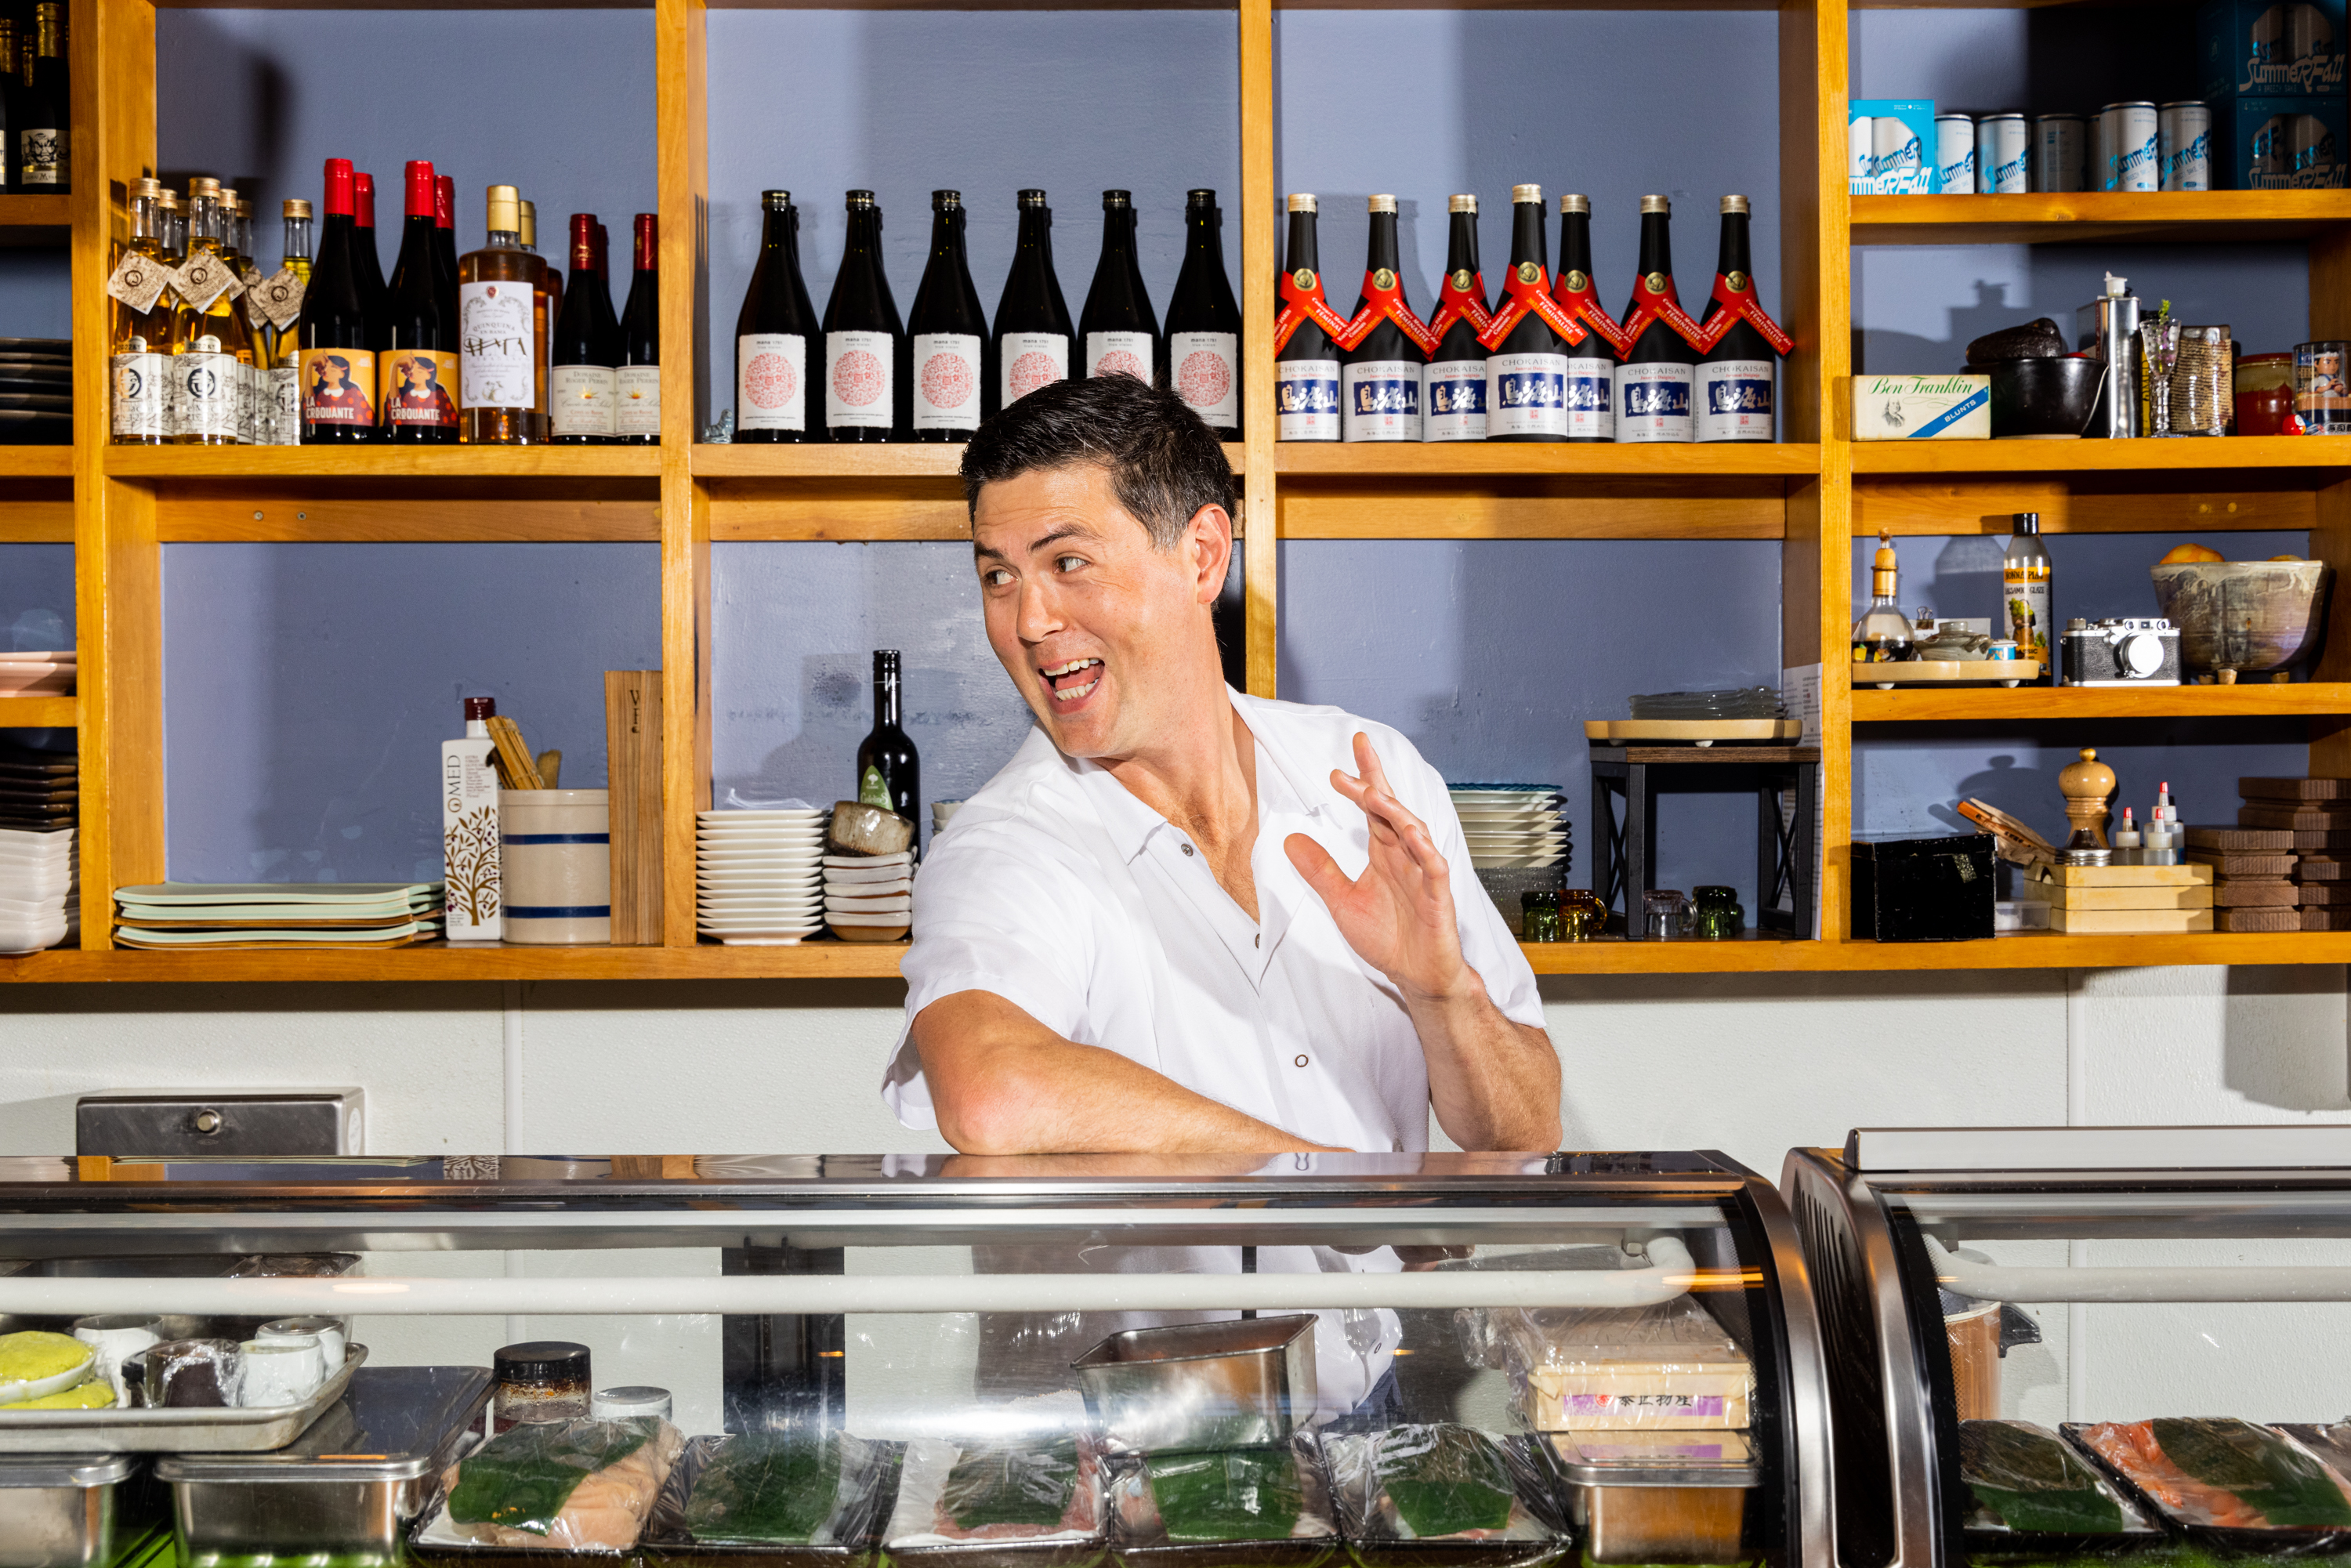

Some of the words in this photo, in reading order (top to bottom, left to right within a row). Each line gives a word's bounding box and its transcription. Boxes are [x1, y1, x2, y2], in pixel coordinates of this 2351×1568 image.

[1278, 308, 1291, 324] PARIS
[1302, 304, 1317, 317] 2023
[1314, 314, 1333, 331] GOLD
[1310, 296, 1335, 317] Concours
[1332, 314, 1348, 328] Mond
[1391, 297, 1414, 320] Concours
[1411, 317, 1432, 338] Mondial
[1429, 335, 1439, 345] des
[1434, 309, 1447, 324] PARIS
[1458, 305, 1472, 319] 2023
[1467, 296, 1489, 320] Concours
[1481, 328, 1493, 340] Kura
[1490, 314, 1504, 330] Master
[1501, 301, 1516, 317] PARIS
[1525, 296, 1540, 311] 2023
[1538, 308, 1556, 326] GOLD
[1552, 322, 1575, 345] MEDAL
[1534, 288, 1557, 311] Concours
[1556, 309, 1576, 329] Mondial
[1574, 327, 1584, 337] des
[1583, 298, 1606, 319] Concours
[1603, 317, 1625, 336] Mondial
[1622, 334, 1632, 344] des
[1629, 309, 1642, 325] PARIS
[1661, 297, 1684, 318] Concours
[1683, 317, 1703, 335] Mondial
[1701, 333, 1712, 342] des
[473, 322, 515, 332] QUINQUINA
[1336, 330, 1348, 342] Kura
[1345, 319, 1359, 333] Master
[1356, 307, 1371, 322] PARIS
[1345, 338, 1357, 349] 2023
[1353, 327, 1367, 341] GOLD
[1364, 314, 1382, 331] MEDAL
[1347, 320, 1367, 339] Concours
[1382, 305, 1396, 319] 2023
[1394, 316, 1412, 334] GOLD
[1409, 331, 1431, 353] MEDAL
[1490, 335, 1502, 349] 2023
[1498, 323, 1513, 338] GOLD
[1509, 307, 1526, 325] MEDAL
[1492, 315, 1511, 335] Concours
[1574, 305, 1588, 319] 2023
[1586, 316, 1605, 333] GOLD
[1602, 330, 1625, 351] MEDAL
[1653, 305, 1667, 319] 2023
[1665, 316, 1683, 332] GOLD
[1681, 329, 1704, 349] MEDAL
[1737, 306, 1751, 319] 2023
[1748, 317, 1766, 334] GOLD
[1763, 331, 1785, 353] MEDAL
[1744, 298, 1766, 320] Concours
[1765, 318, 1784, 339] Mondial
[1782, 336, 1792, 346] des
[1278, 365, 1335, 374] CHOKAISAN
[1357, 365, 1415, 375] CHOKAISAN
[1433, 365, 1485, 375] CHOKAISA
[1502, 358, 1560, 367] CHOKAISAN
[1628, 368, 1686, 376] CHOKAISAN
[1712, 365, 1769, 374] CHOKAISAN
[1357, 384, 1417, 412] 鳥海山
[1502, 378, 1563, 405] 鳥海山
[1568, 383, 1609, 407] 海山
[1712, 384, 1771, 411] 鳥海山
[1868, 375, 1903, 395] Ben
[1904, 375, 1973, 395] Franklin
[306, 397, 316, 407] LA
[391, 397, 401, 408] LA
[1628, 386, 1689, 414] 鳥海山
[1943, 399, 1976, 423] BLUNTS
[446, 755, 462, 813] OMED
